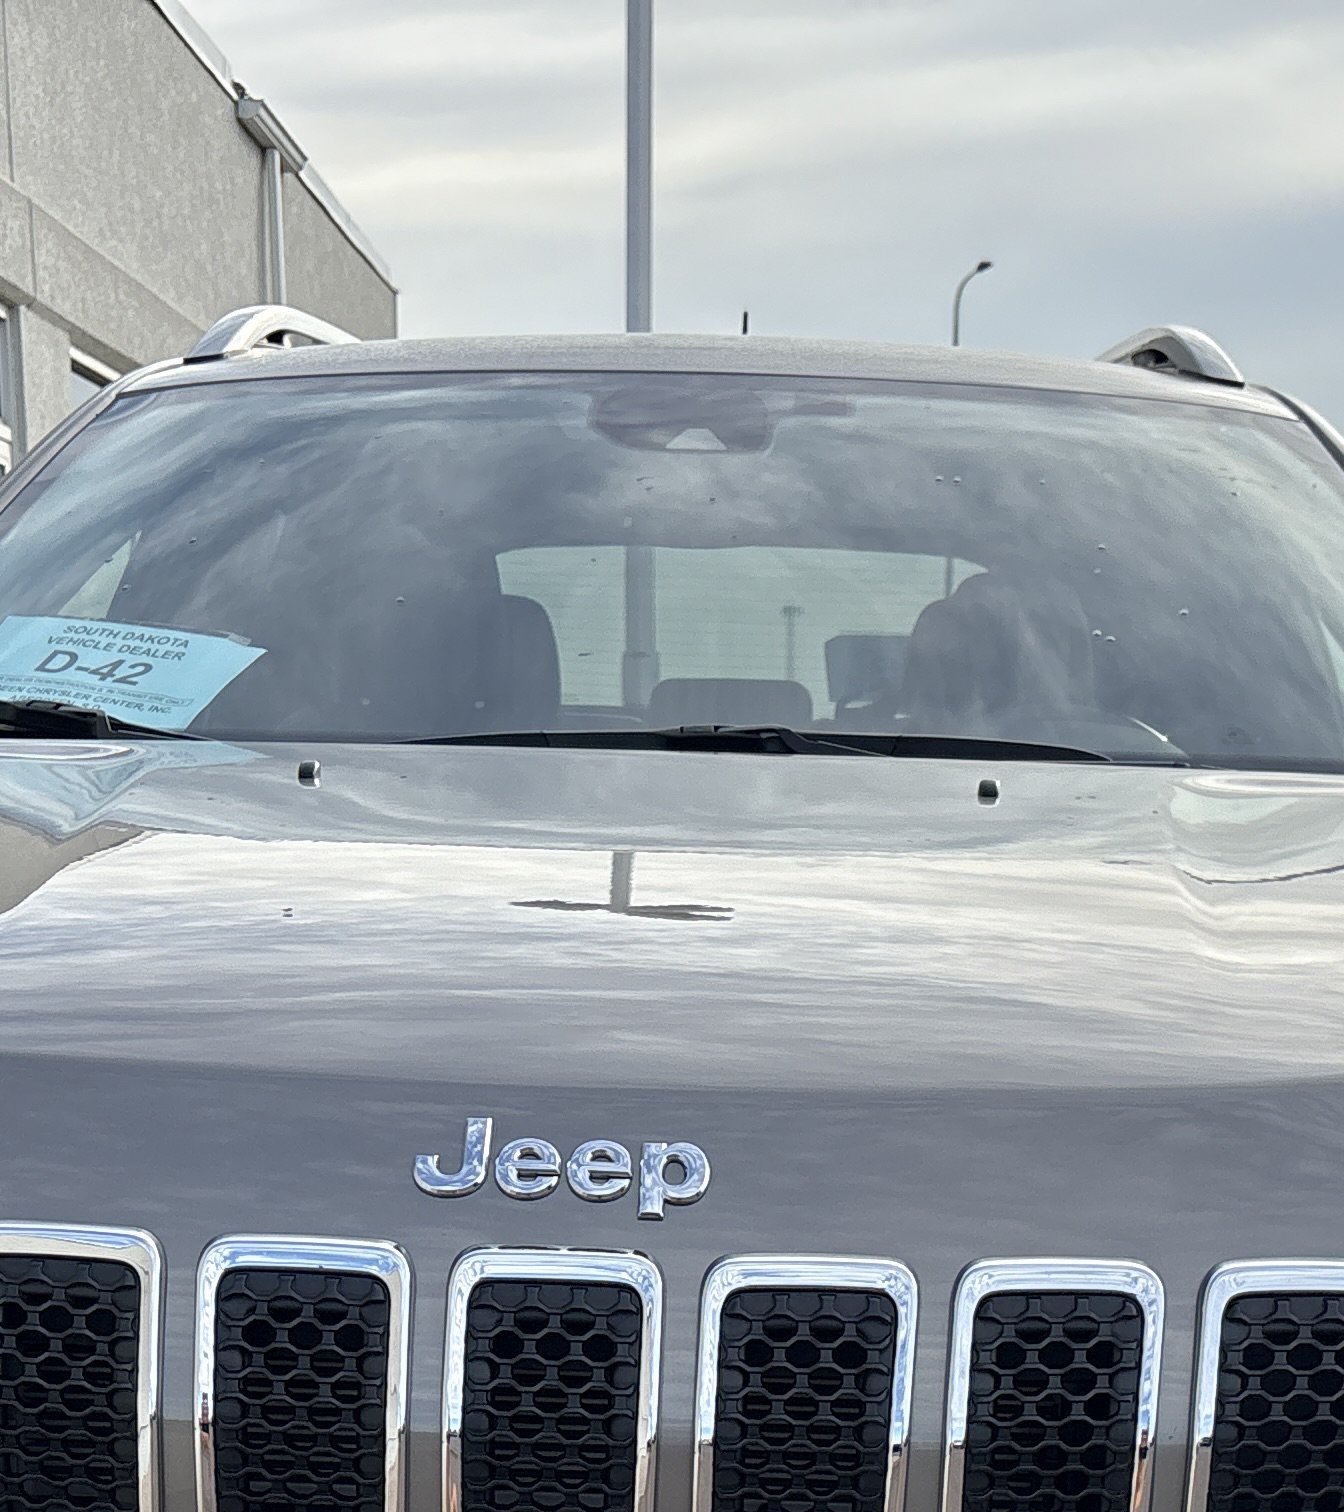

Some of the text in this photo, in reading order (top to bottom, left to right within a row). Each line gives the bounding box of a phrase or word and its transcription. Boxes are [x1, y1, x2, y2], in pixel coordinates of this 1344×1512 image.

[47, 636, 187, 661] VEHICLE DEALER
[63, 625, 189, 649] SOUTH DAKOTA
[34, 650, 153, 686] D-42
[26, 686, 92, 701] CHRYSLER
[413, 1116, 712, 1221] Jeep
